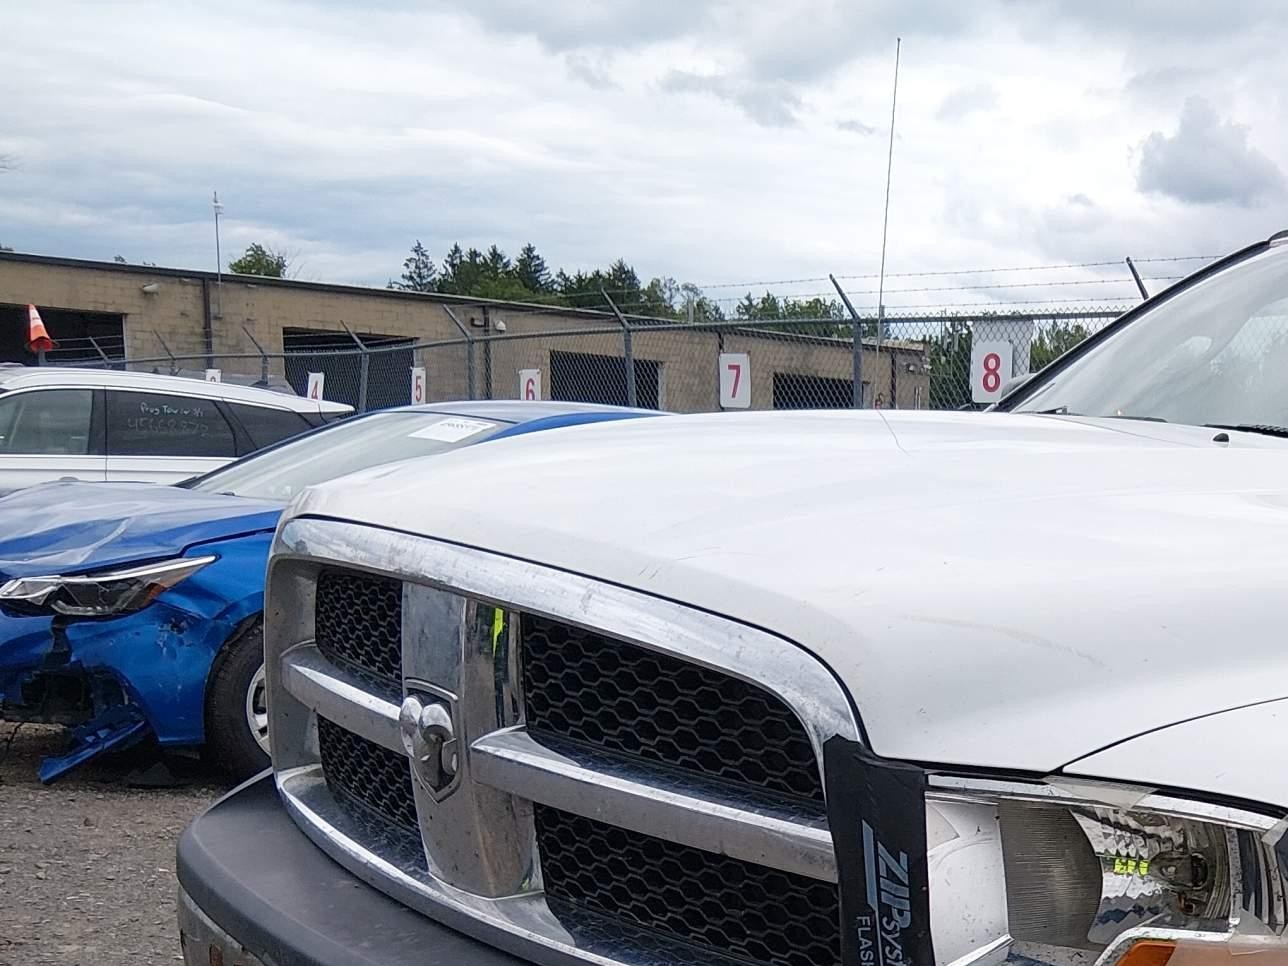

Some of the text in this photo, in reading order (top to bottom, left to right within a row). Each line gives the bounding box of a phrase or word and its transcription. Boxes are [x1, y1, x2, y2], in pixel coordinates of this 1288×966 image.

[728, 365, 740, 398] 7
[982, 353, 1000, 393] 8
[311, 380, 318, 399] 4
[416, 376, 421, 401] 5
[525, 377, 536, 400] 6
[878, 841, 910, 928] ZIP
